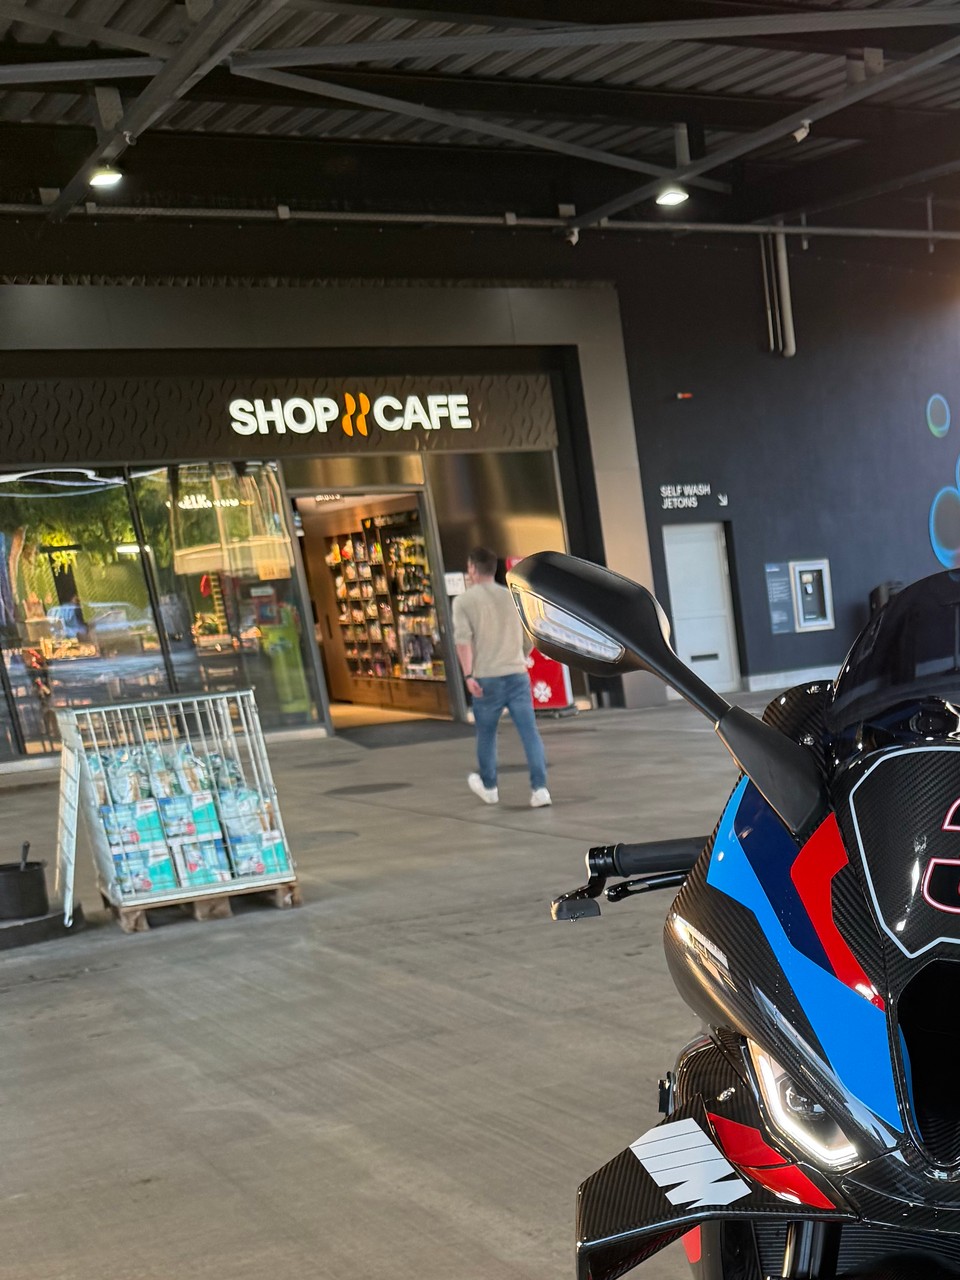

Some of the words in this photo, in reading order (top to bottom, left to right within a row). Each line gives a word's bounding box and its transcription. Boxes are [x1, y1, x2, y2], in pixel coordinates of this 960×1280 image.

[229, 397, 339, 436] SHOP
[373, 394, 472, 432] CAFE
[660, 485, 682, 497] SELF
[683, 483, 711, 496] WASH
[662, 496, 698, 509] JETONS
